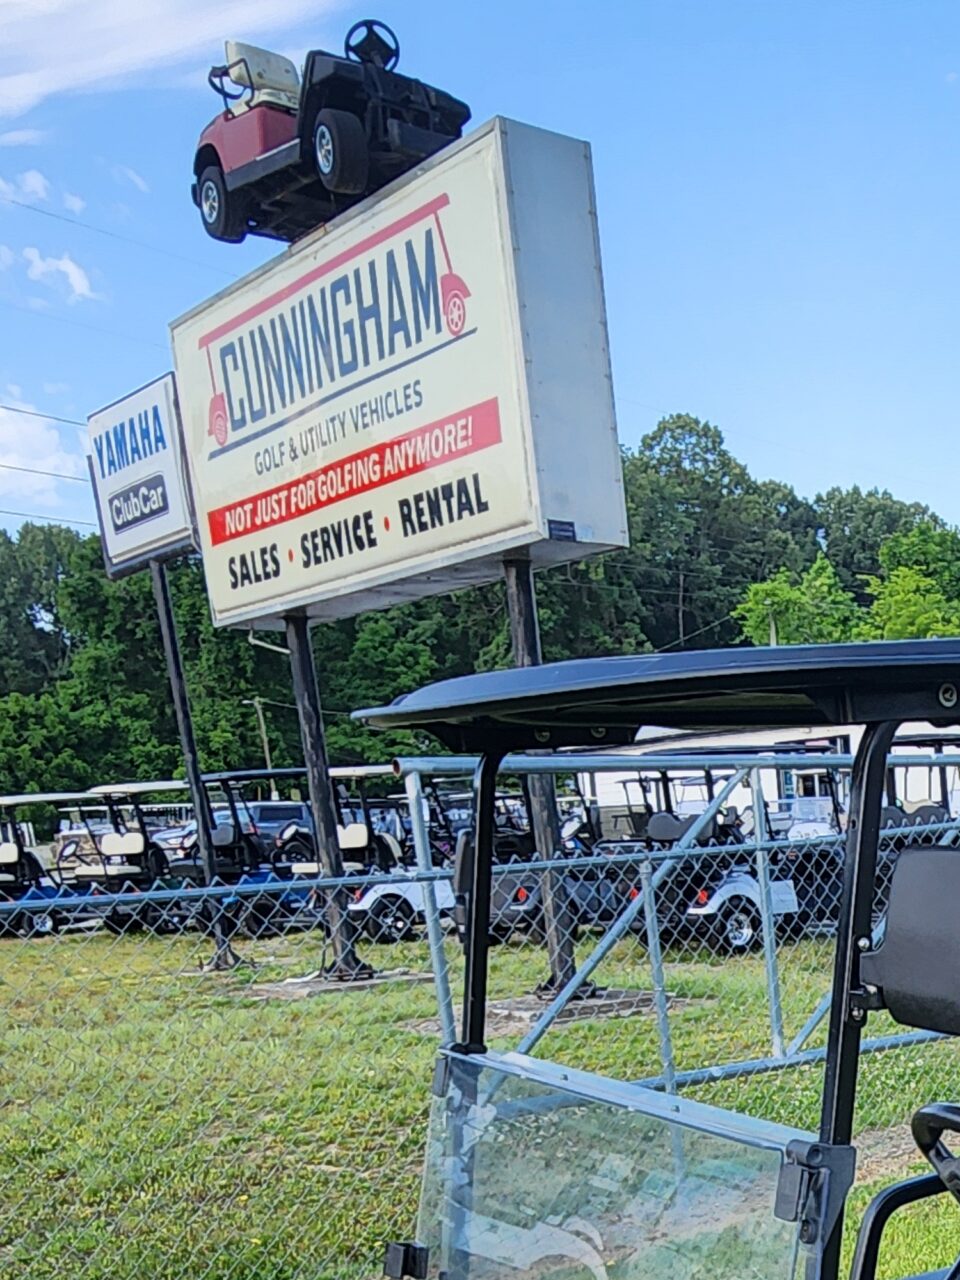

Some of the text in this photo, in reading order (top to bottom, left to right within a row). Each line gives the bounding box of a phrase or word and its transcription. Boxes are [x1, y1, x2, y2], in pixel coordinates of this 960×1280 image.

[220, 227, 442, 432] CUNNINGHAM
[93, 405, 167, 479] YAMAHA
[224, 415, 473, 536] NOT JUST FOR GOLFING ANYMORE!
[254, 379, 423, 476] GOLF & UTILITY VEHICLES
[111, 485, 164, 526] ClubCar
[228, 472, 489, 590] SALES SERVICE RENTAL
